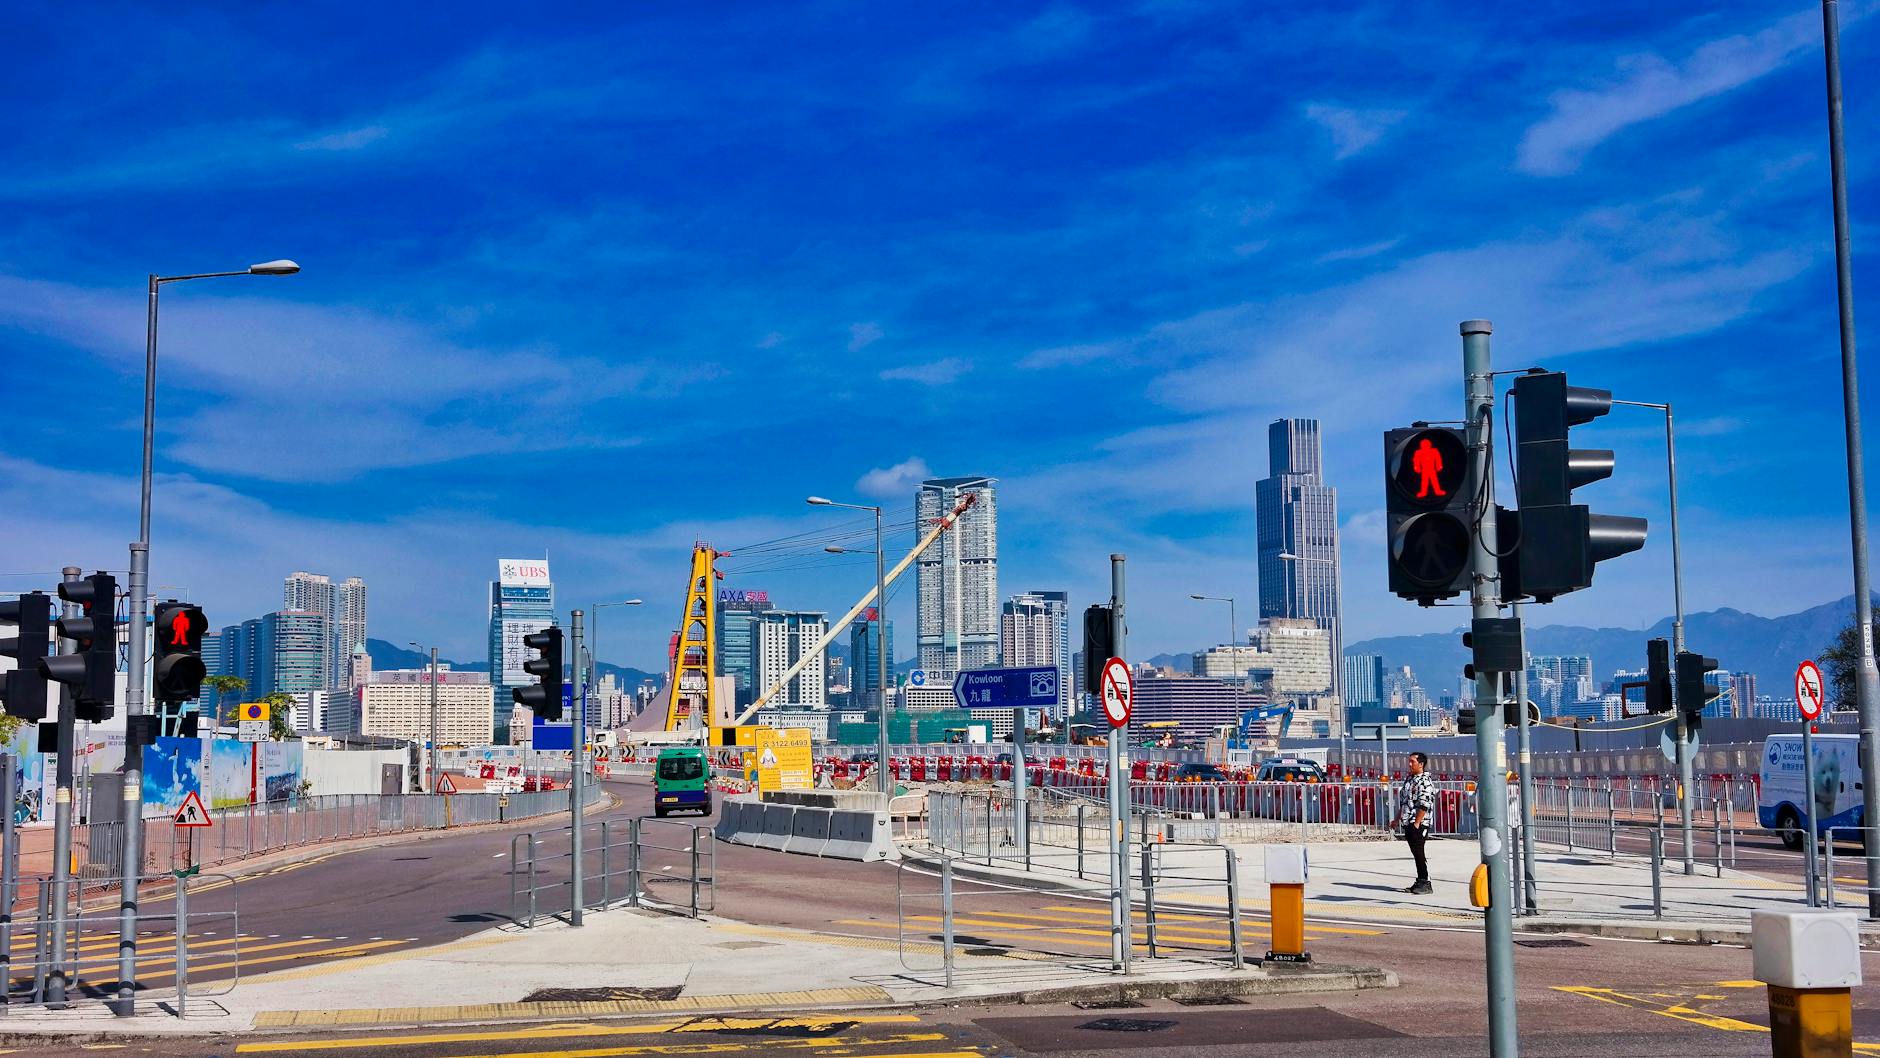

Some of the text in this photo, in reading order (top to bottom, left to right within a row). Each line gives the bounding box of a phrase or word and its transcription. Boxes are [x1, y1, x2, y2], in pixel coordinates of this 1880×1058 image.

[519, 566, 547, 578] UBS
[719, 590, 745, 602] AXA
[968, 674, 1003, 685] Kowloon
[969, 689, 992, 703] 九龍
[1783, 742, 1804, 752] SNOW
